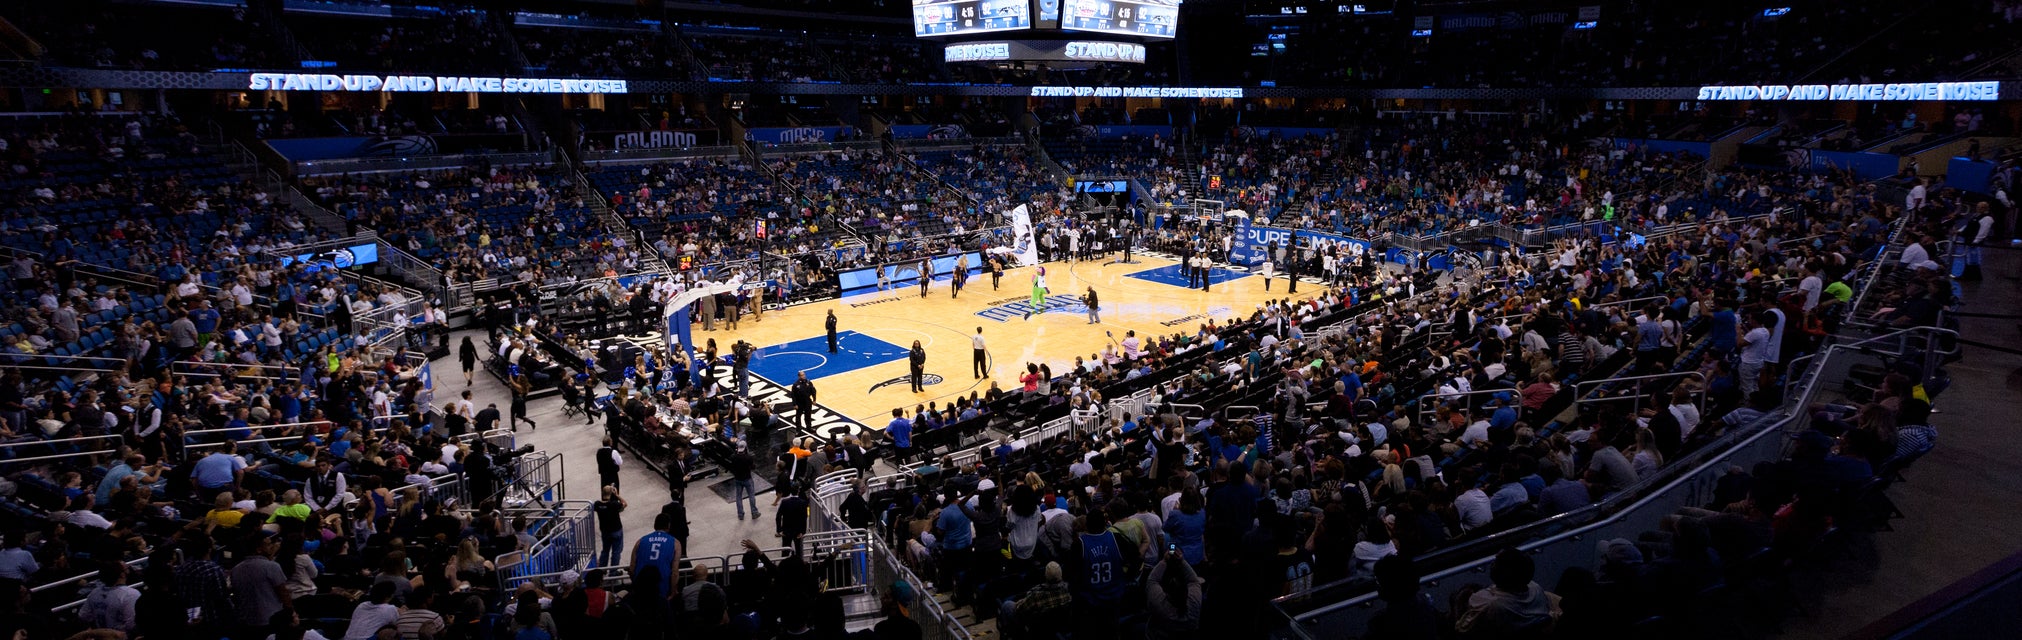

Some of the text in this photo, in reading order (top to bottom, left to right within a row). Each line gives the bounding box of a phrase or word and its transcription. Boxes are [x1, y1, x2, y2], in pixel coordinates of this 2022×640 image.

[963, 43, 1009, 60] NOISE!
[1064, 41, 1118, 59] STAND
[1116, 44, 1134, 60] UP
[250, 73, 628, 94] STAND UP AND MAKE SOME NOISE!
[1031, 86, 1243, 98] STAND UP AND MAKE SOME NOISE!
[1698, 81, 1999, 101] STAND UP AND MAKE SOME NOISE!
[614, 130, 697, 151] ORLANDO
[1248, 229, 1291, 248] PURE
[742, 281, 768, 290] GEICO
[649, 542, 662, 561] 5
[1090, 544, 1109, 558] HILL
[1090, 561, 1112, 585] 33
